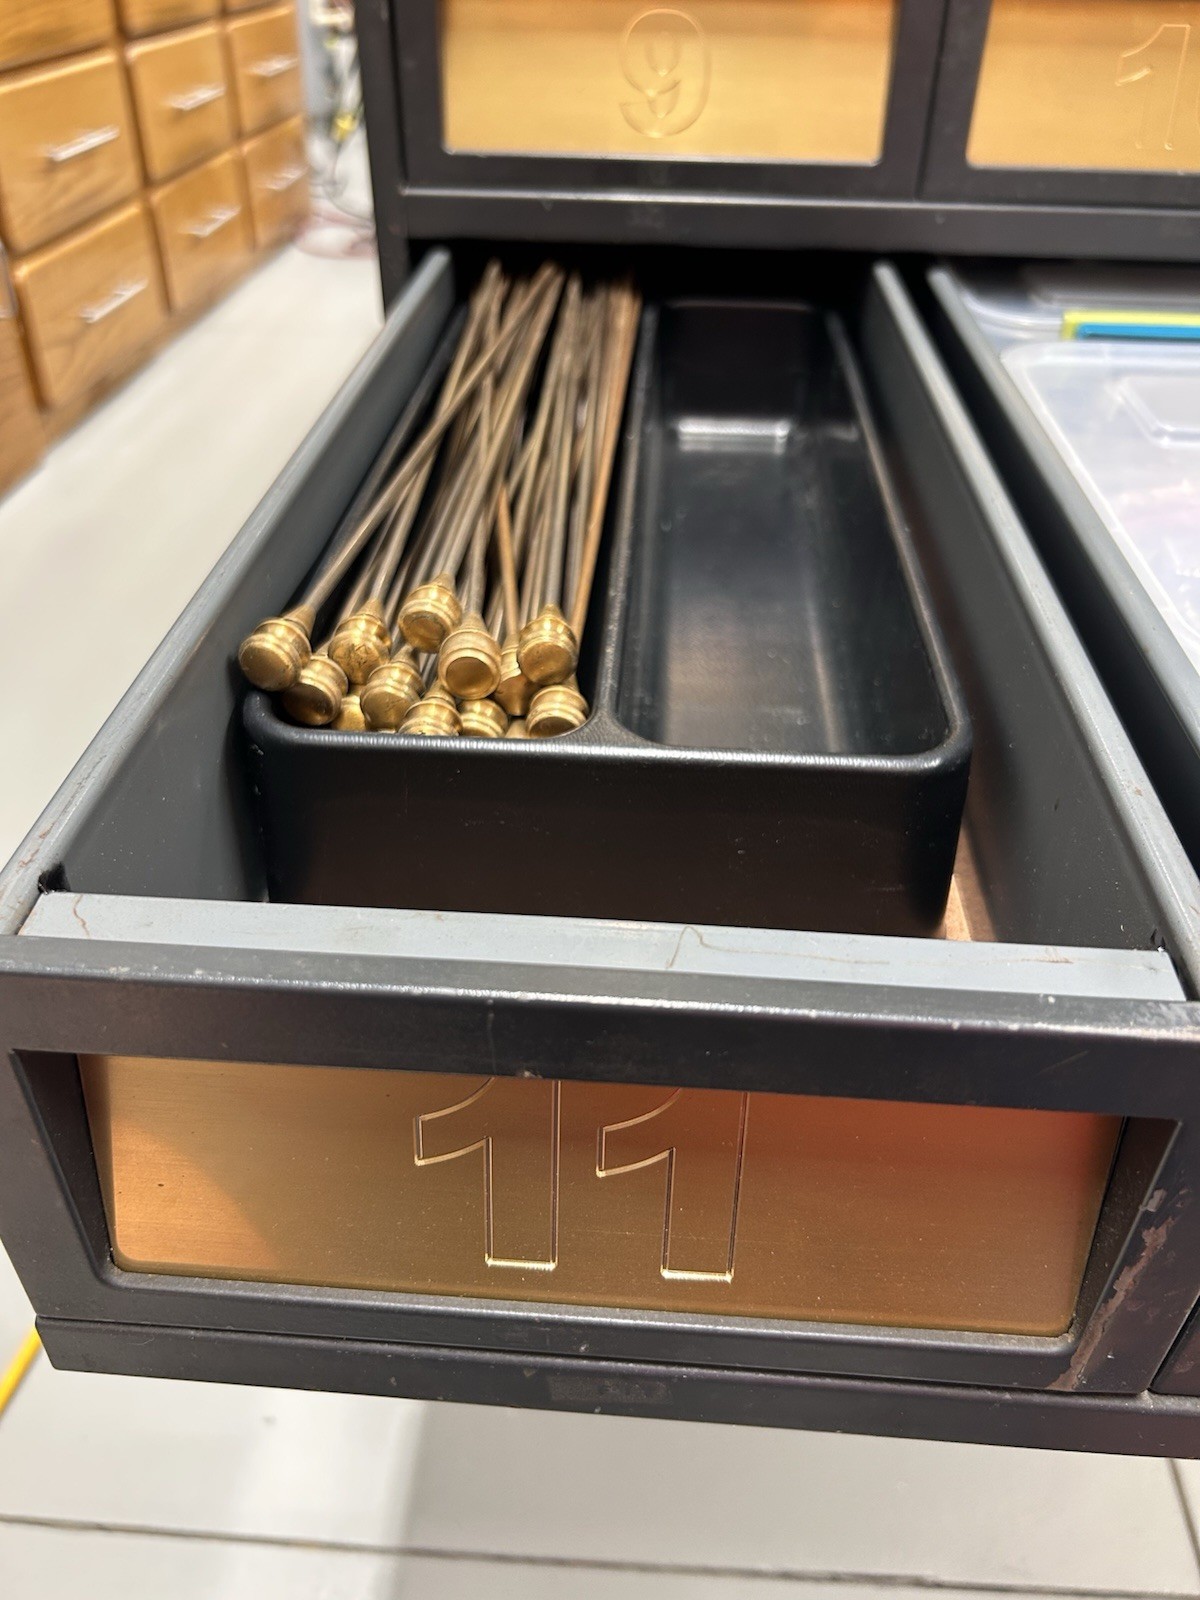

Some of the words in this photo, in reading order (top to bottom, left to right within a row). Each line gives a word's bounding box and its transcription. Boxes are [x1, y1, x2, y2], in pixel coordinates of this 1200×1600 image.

[619, 8, 711, 139] 9
[1115, 23, 1200, 150] 1
[412, 1076, 750, 1282] 11
